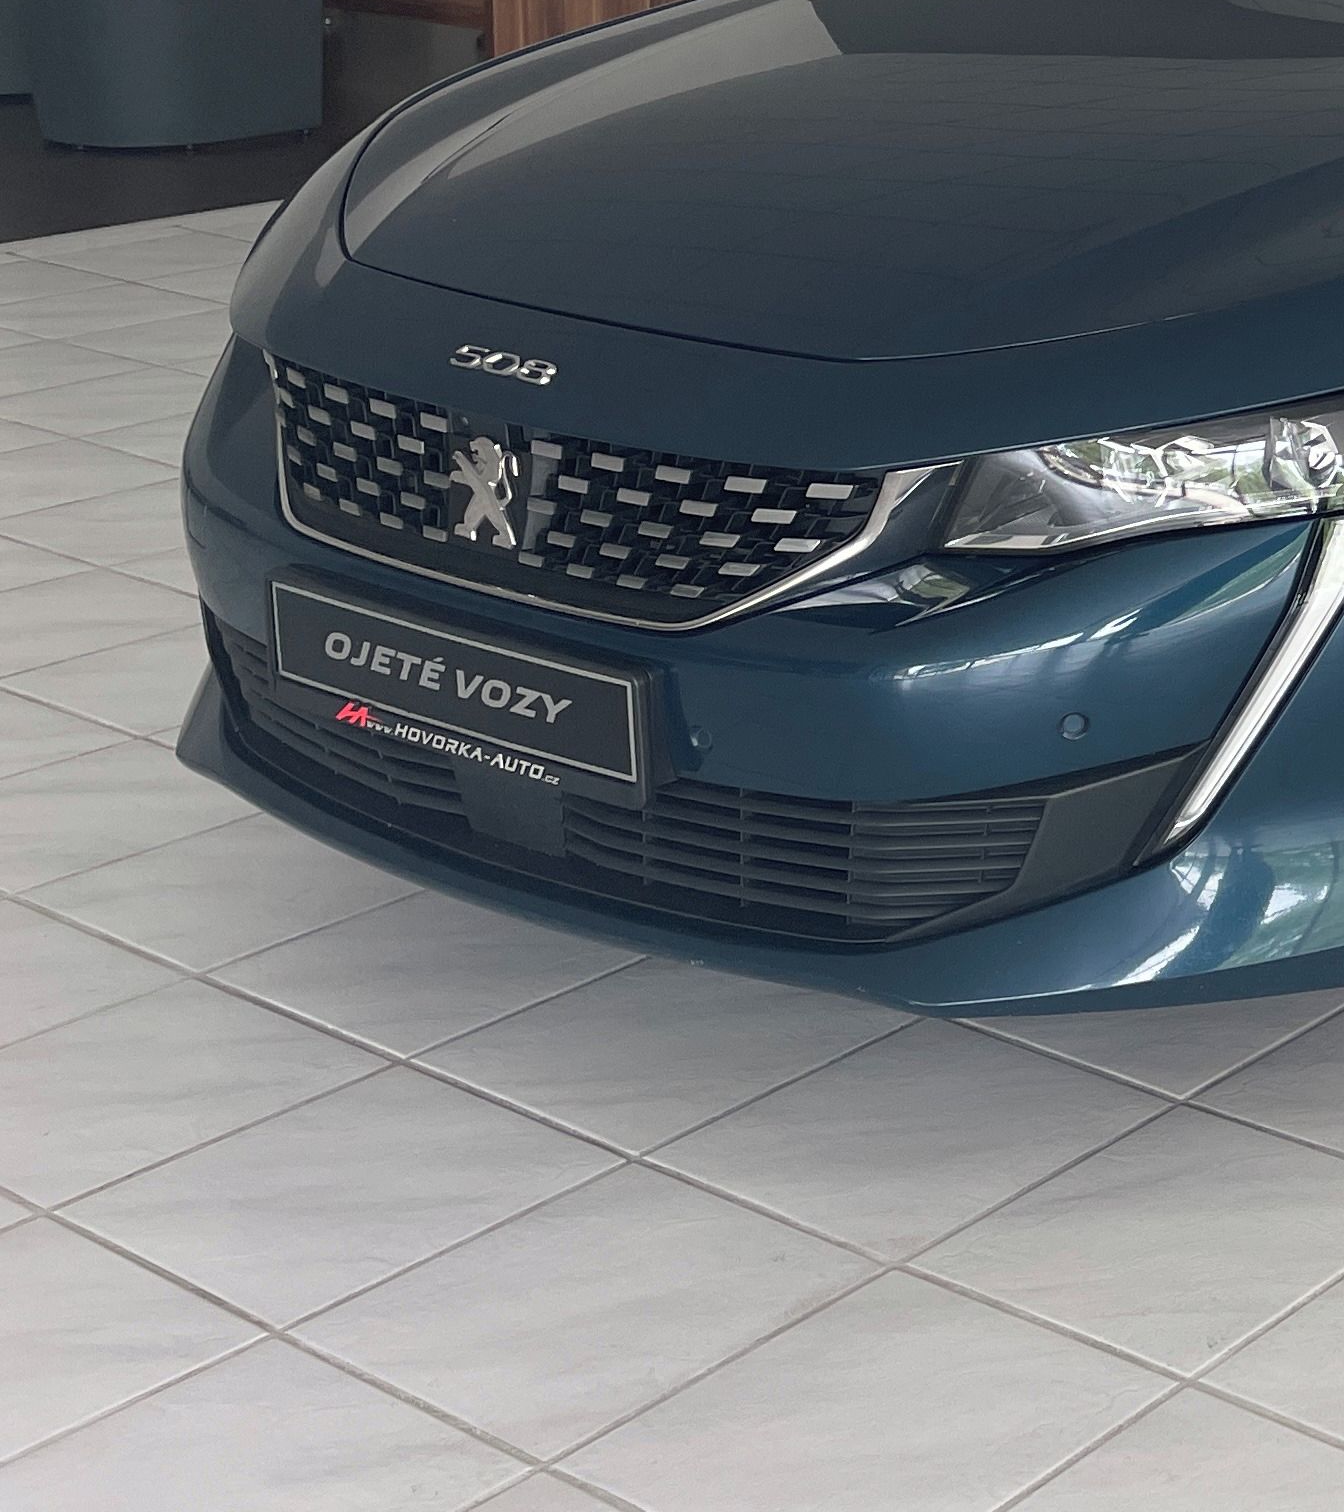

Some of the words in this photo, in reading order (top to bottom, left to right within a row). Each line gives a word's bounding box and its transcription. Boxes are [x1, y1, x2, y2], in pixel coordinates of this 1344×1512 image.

[450, 344, 558, 385] 508
[325, 631, 446, 691] OJETÉ
[455, 669, 572, 723] VOZY
